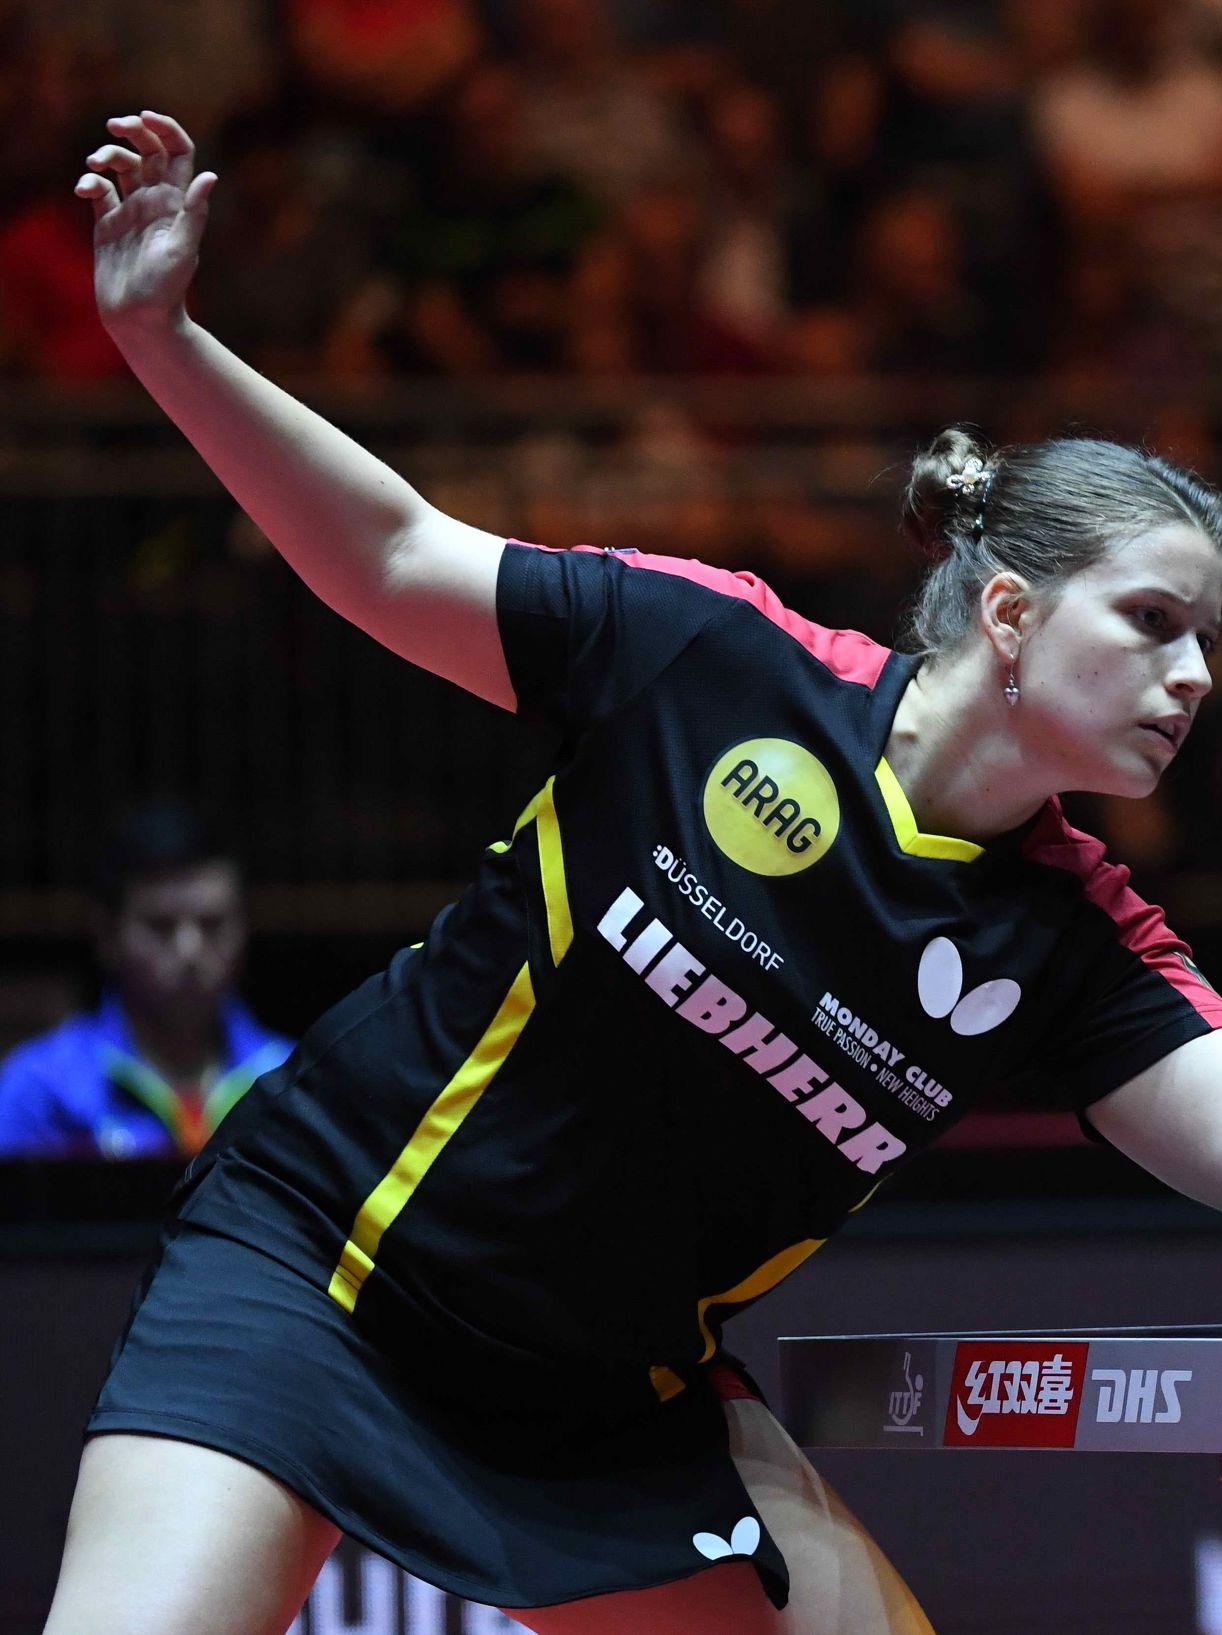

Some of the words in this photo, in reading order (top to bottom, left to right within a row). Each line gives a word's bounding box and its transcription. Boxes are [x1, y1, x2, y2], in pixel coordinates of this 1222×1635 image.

[721, 759, 821, 853] ARAG
[597, 886, 907, 1175] LIEBHERR
[811, 1007, 836, 1036] TRUE
[833, 1028, 872, 1069] PASSION
[875, 1067, 904, 1093] NEW
[898, 1086, 940, 1121] HEIGHTS
[819, 992, 905, 1067] MONDAY
[906, 1066, 953, 1107] CLUB
[957, 1354, 1074, 1436] 红双喜
[1092, 1369, 1193, 1423] DHS
